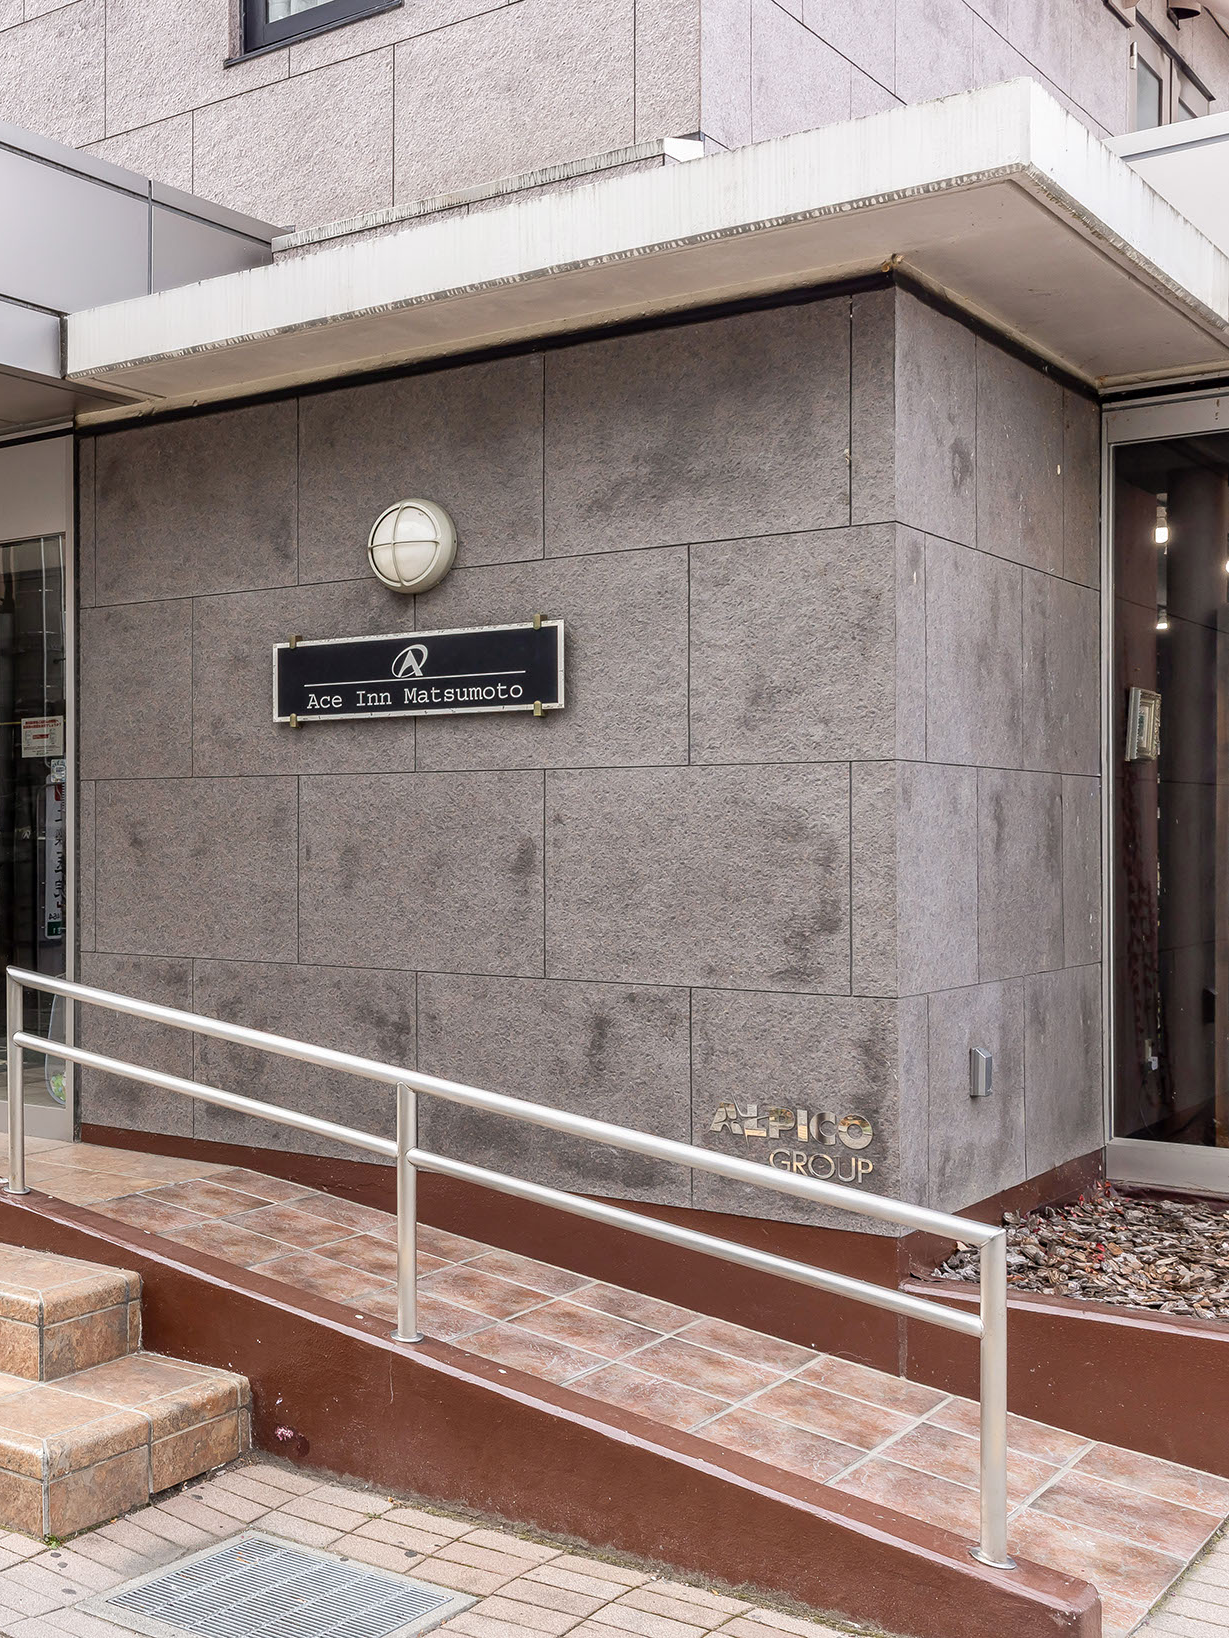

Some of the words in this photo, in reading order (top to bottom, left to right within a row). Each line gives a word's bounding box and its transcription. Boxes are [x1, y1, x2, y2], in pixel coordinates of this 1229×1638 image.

[306, 693, 343, 709] Ace
[356, 690, 392, 707] Inn
[404, 682, 523, 704] Matsumoto
[708, 1094, 873, 1150] ALPICO
[769, 1148, 873, 1183] GROUP
